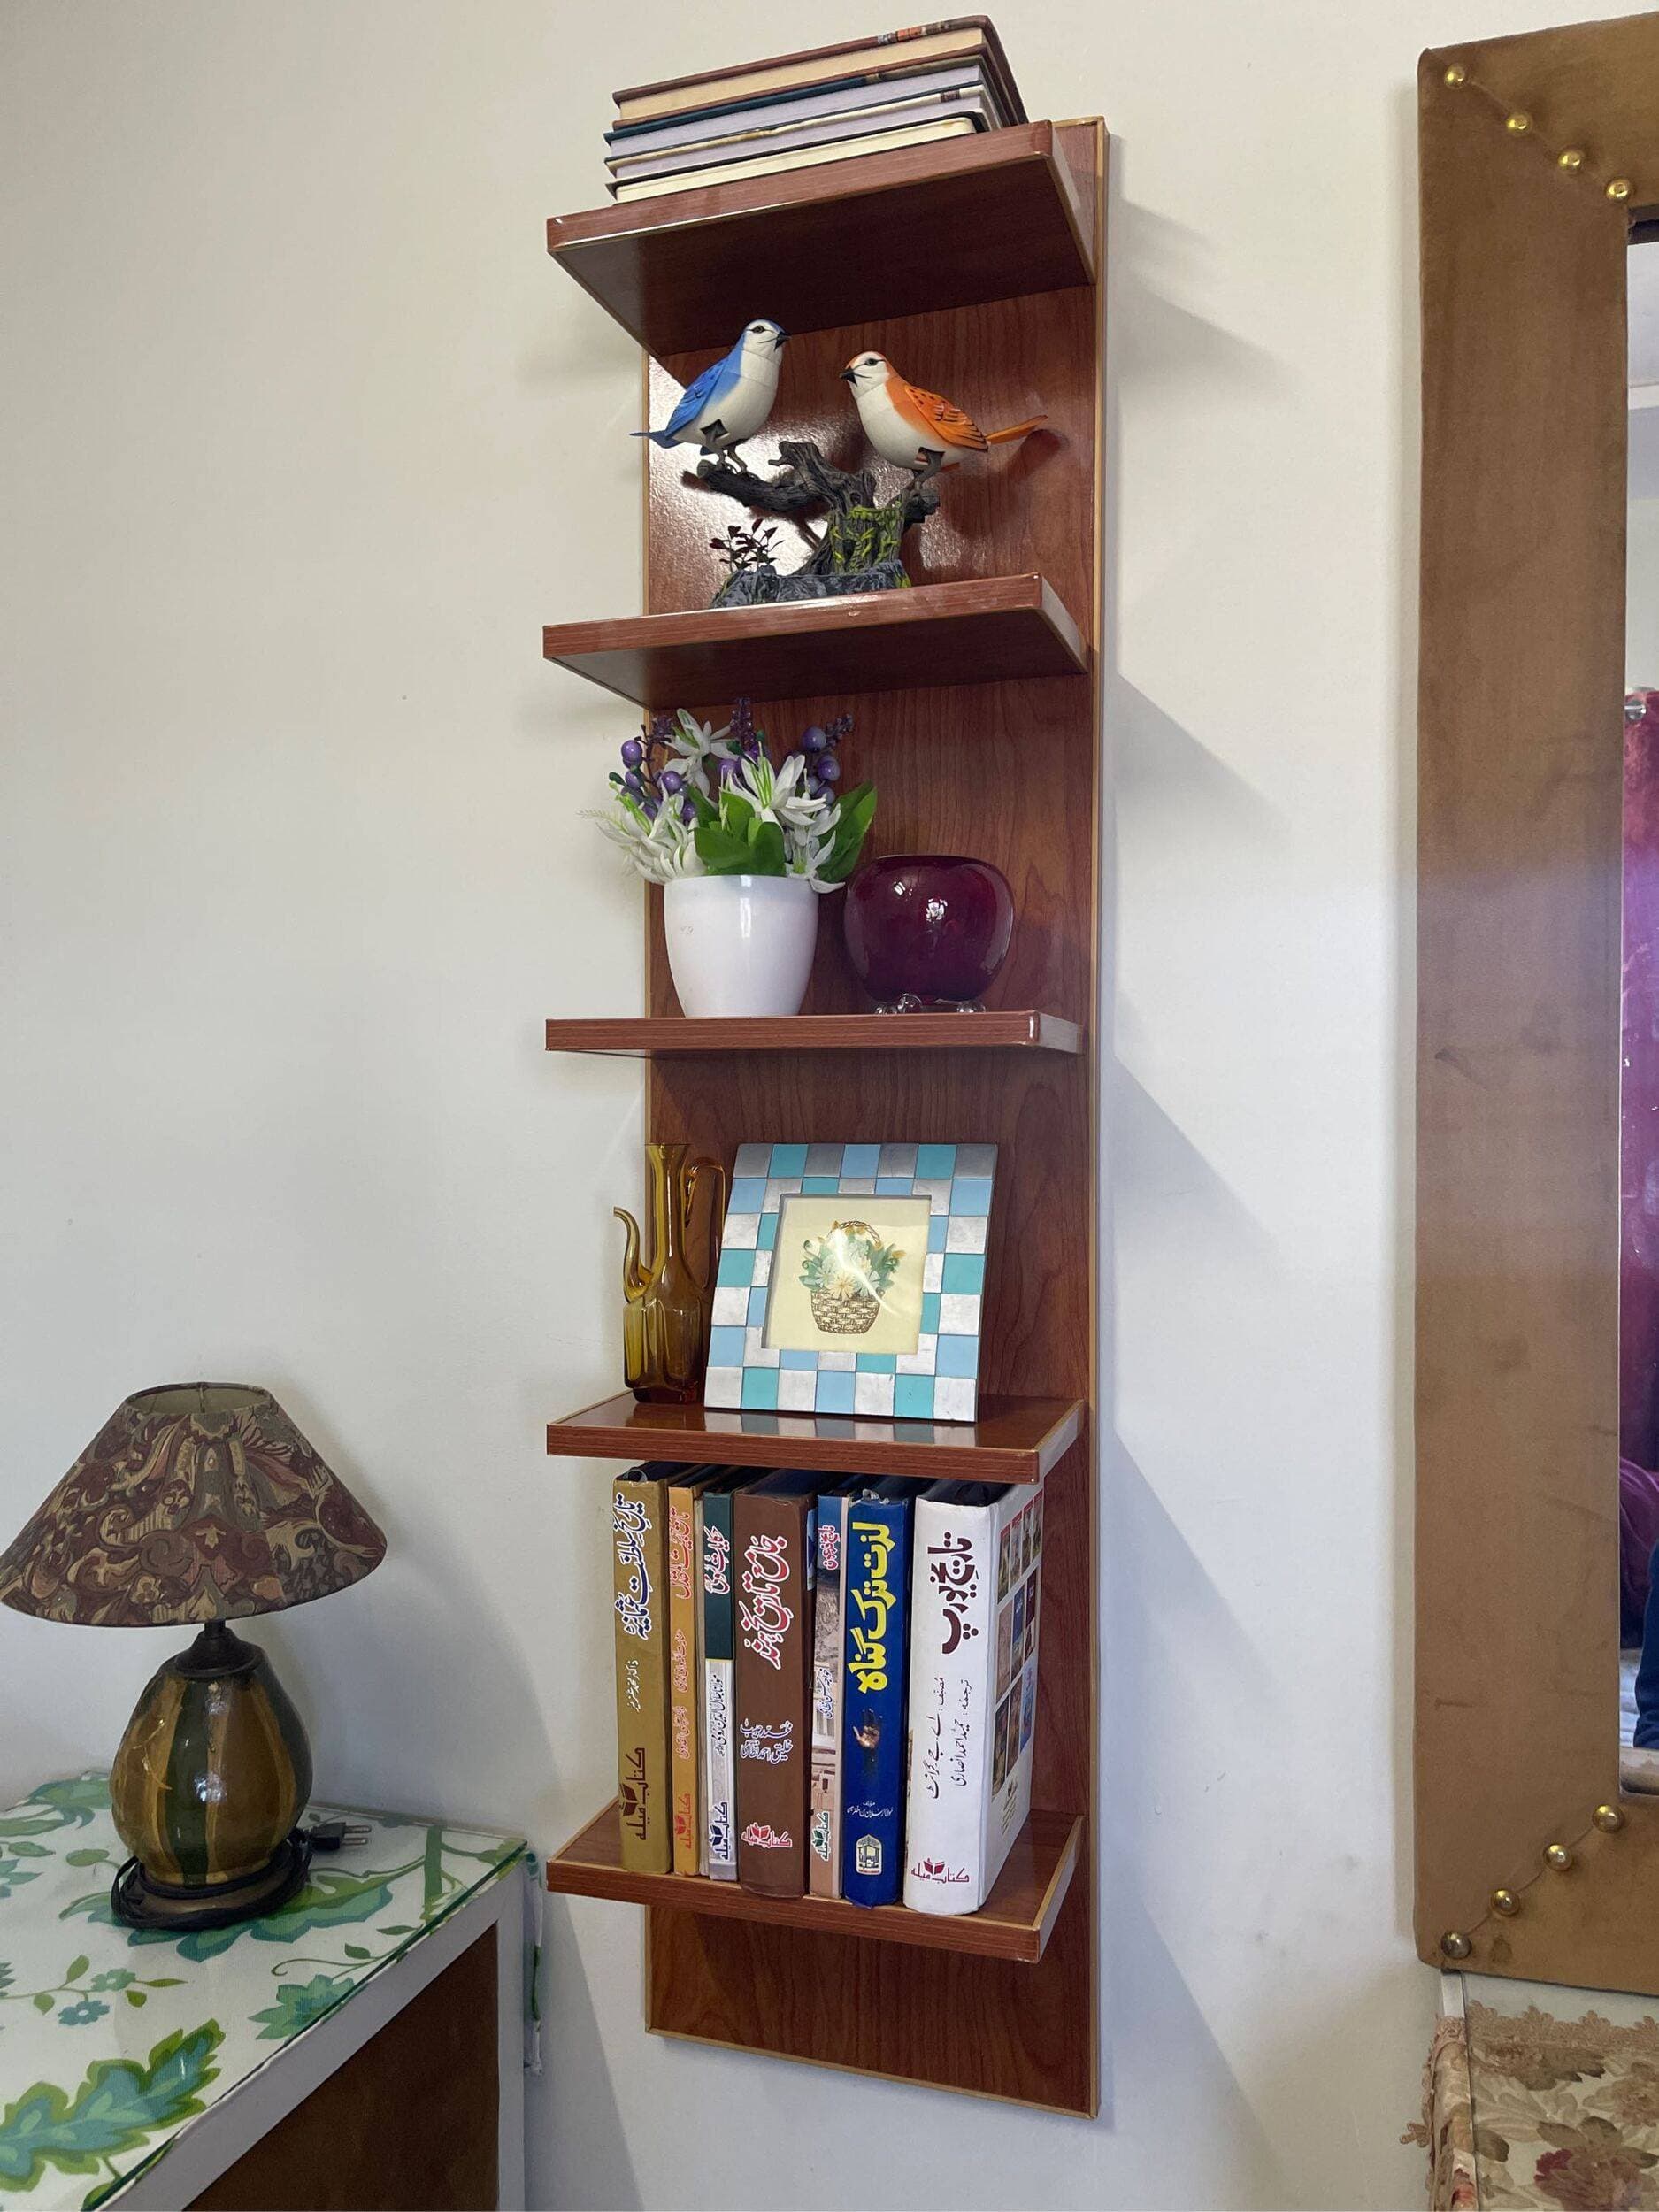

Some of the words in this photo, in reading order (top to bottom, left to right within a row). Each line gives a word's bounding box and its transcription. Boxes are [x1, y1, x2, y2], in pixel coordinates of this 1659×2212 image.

[613, 1493, 652, 1532] تاریخ
[616, 1528, 653, 1605] سلطنت
[703, 1525, 730, 1571] حکایات
[744, 1535, 790, 1582] جامع
[851, 1522, 895, 1578] لذت
[927, 1532, 979, 1586] تاریخ
[739, 1571, 794, 1632] تاریخ
[850, 1580, 896, 1640] ترک
[938, 1584, 979, 1655] یورپ
[744, 1631, 784, 1670] ہند
[847, 1627, 887, 1694] گناہ
[625, 1747, 649, 1804] کتاب
[713, 1802, 731, 1836] کتاب
[759, 1831, 792, 1848] کتاب
[816, 1812, 831, 1841] کتاب
[932, 1867, 970, 1884] کتاب
